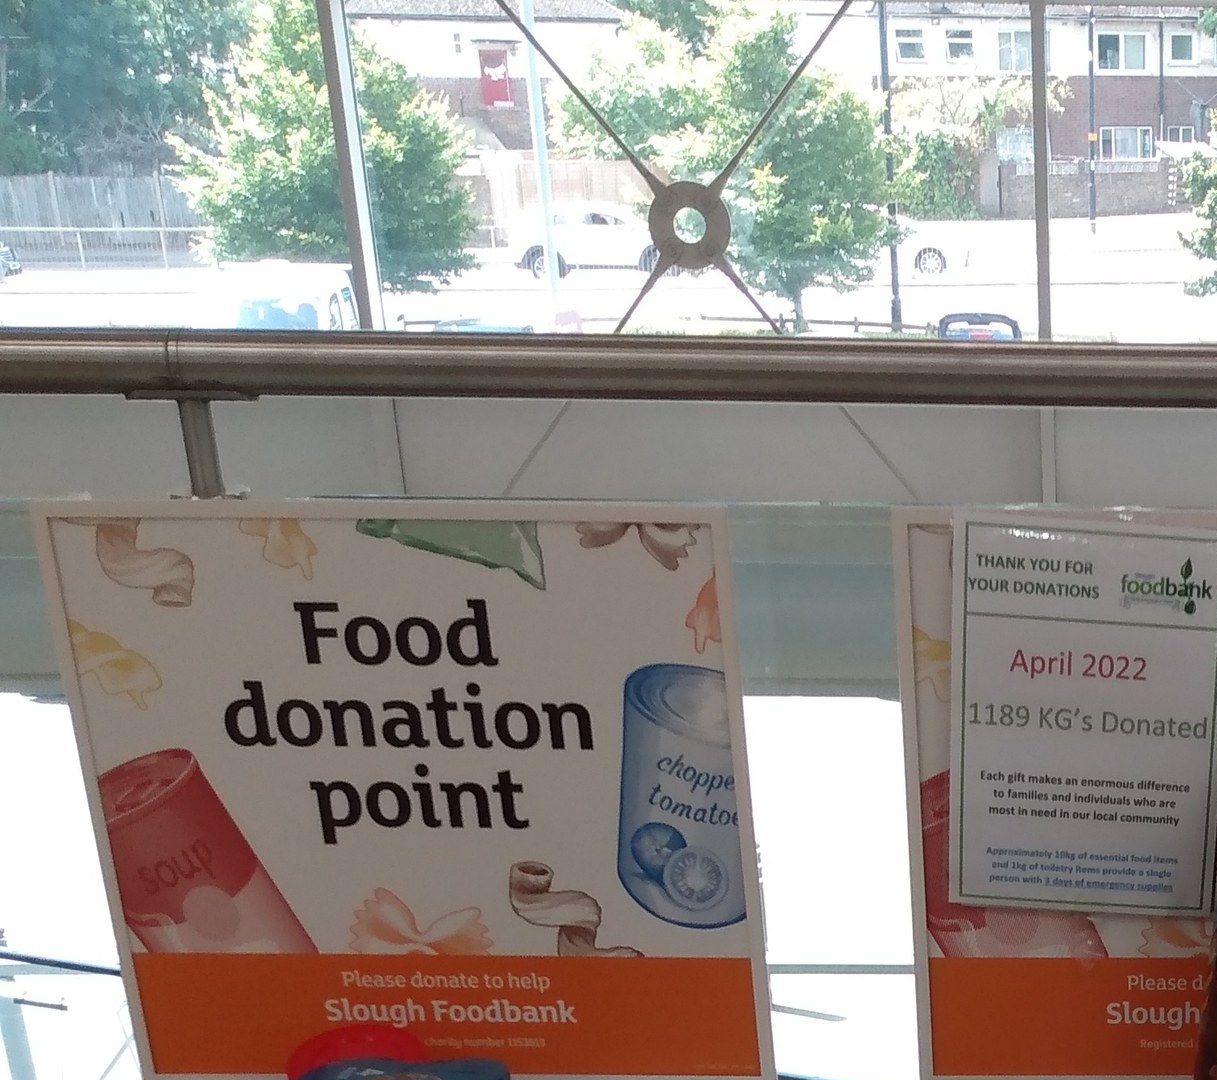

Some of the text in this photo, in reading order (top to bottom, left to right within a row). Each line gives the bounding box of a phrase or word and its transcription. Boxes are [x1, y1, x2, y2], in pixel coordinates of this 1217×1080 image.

[975, 553, 1093, 575] THANK YOU FOR
[968, 577, 1100, 600] YOUR DONATIONS
[1120, 573, 1212, 600] foodbank
[293, 598, 499, 667] Food
[1009, 649, 1148, 681] April 2022
[223, 680, 594, 751] donation
[968, 702, 1209, 740] 1189 KG's Donated
[656, 753, 736, 791] choppe
[980, 770, 1190, 793] Each gift makes an enormous difference
[310, 763, 530, 844] point
[648, 783, 739, 826] tomatoe
[993, 788, 1177, 809] to families and individuals who are
[988, 804, 1181, 828] most in need in our local community
[138, 836, 214, 896] soup
[986, 846, 1052, 859] Approximately
[1078, 852, 1088, 861] of
[1089, 852, 1129, 863] essential
[1130, 853, 1152, 863] food
[1153, 855, 1179, 865] items
[991, 860, 1009, 869] and
[1011, 861, 1027, 872] 1kg
[1029, 862, 1039, 871] of
[1040, 863, 1073, 874] toiletry
[1075, 865, 1101, 875] items
[1102, 866, 1136, 878] provide
[1145, 869, 1172, 880] single
[989, 873, 1020, 885] person
[1022, 874, 1043, 884] with
[1052, 877, 1073, 888] days
[1075, 878, 1085, 888] of
[1086, 880, 1136, 892] emergency
[1137, 882, 1174, 893] supplies
[341, 970, 551, 994] Please donate to help
[1127, 974, 1186, 991] Please
[324, 997, 578, 1029] Slough Foodbank
[1106, 1001, 1201, 1031] Slough
[1140, 1039, 1194, 1049] Registered
